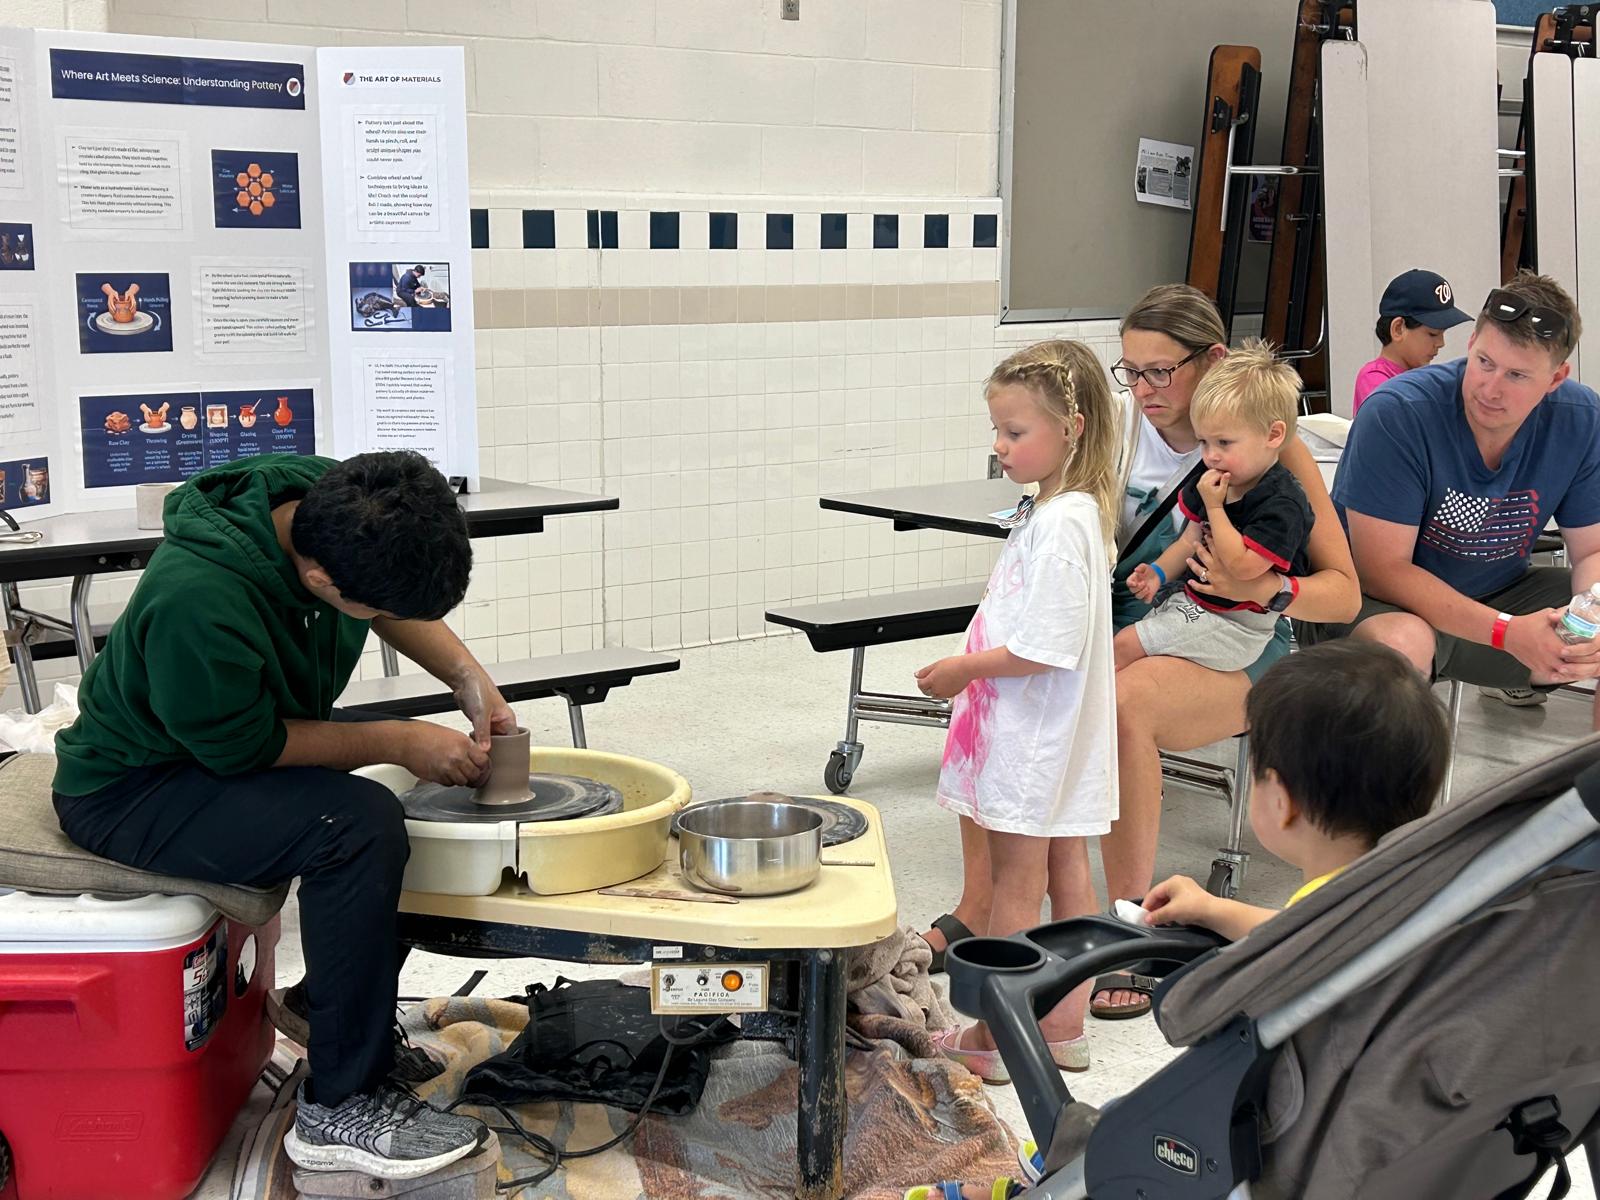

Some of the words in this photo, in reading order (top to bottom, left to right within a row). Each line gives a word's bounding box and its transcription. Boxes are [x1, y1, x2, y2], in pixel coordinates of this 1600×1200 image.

[61, 69, 93, 81] Where
[95, 71, 110, 81] Art
[111, 72, 140, 83] Meets
[142, 74, 181, 85] Science:
[183, 77, 250, 90] Understanding
[251, 80, 283, 93] Pottery
[1157, 1140, 1194, 1171] chicco
